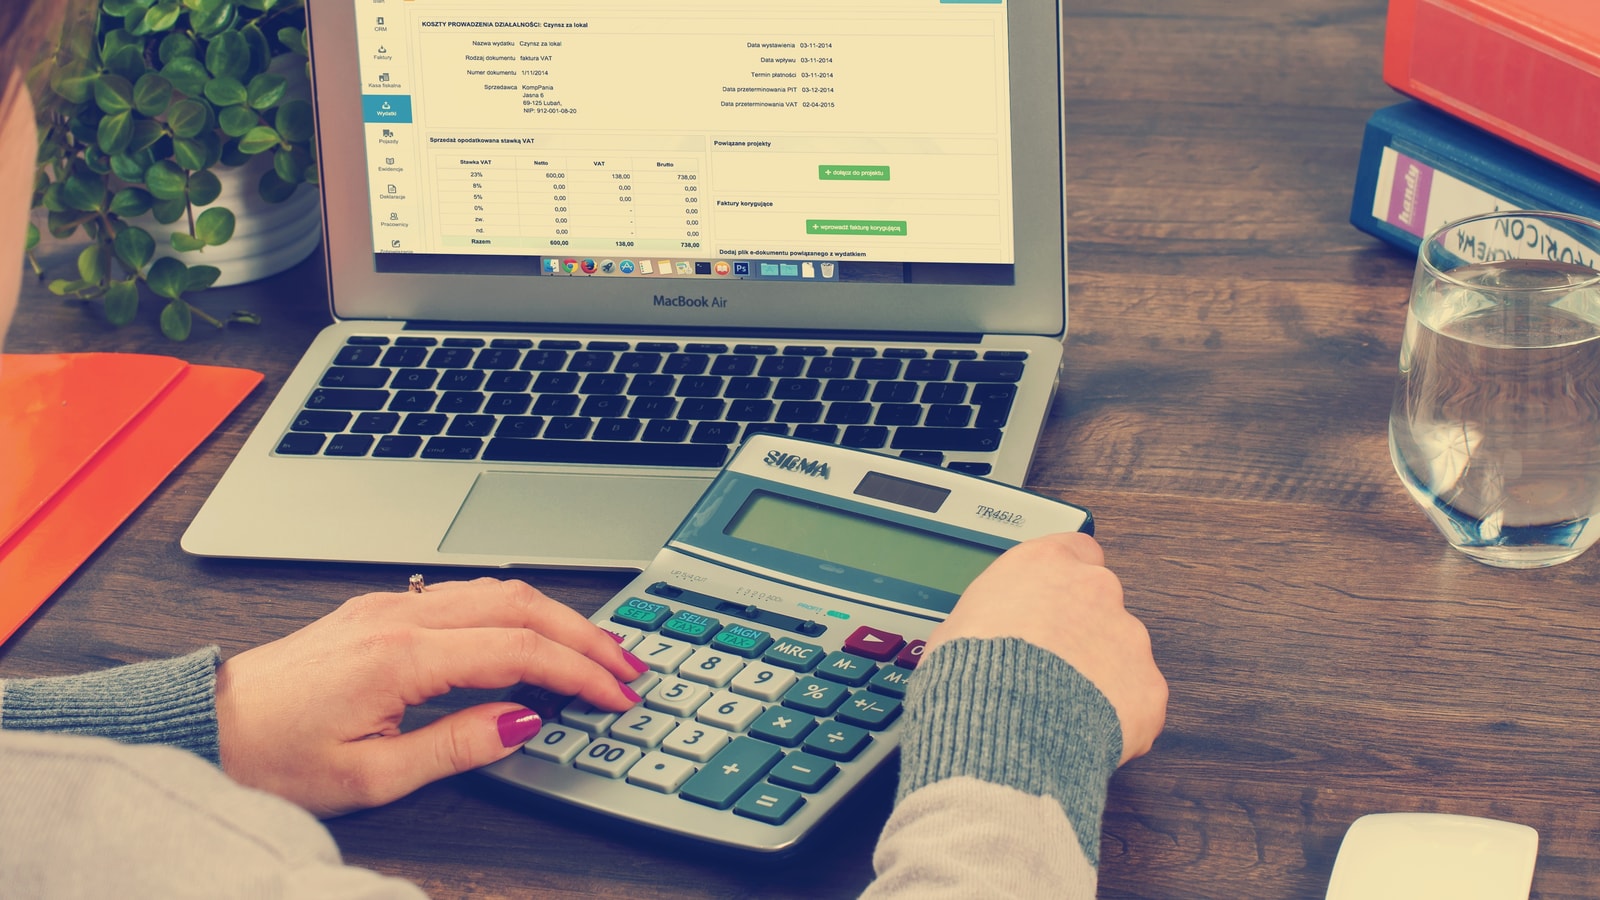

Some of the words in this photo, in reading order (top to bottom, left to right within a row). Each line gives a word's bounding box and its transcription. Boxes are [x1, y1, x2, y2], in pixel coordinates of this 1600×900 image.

[465, 54, 484, 62] Rodzaj
[1398, 164, 1419, 225] handy
[653, 295, 709, 307] MacBook
[711, 297, 727, 308] Air
[763, 450, 831, 480] SIGMA
[976, 505, 1023, 524] TR4512
[629, 600, 664, 612] COST
[624, 608, 649, 619] SET
[679, 612, 708, 626] SELL
[730, 626, 762, 639] MGN
[649, 643, 672, 656] 7
[774, 642, 813, 658] MRC
[700, 656, 721, 670] 8
[832, 658, 857, 670] M-
[754, 671, 773, 684] 9
[665, 683, 688, 697] 5
[802, 684, 828, 699] %
[718, 701, 738, 715] 6
[629, 715, 652, 731] 2
[544, 730, 566, 745] 0
[683, 730, 704, 745] 3
[589, 743, 625, 762] 00
[756, 794, 778, 807] =
